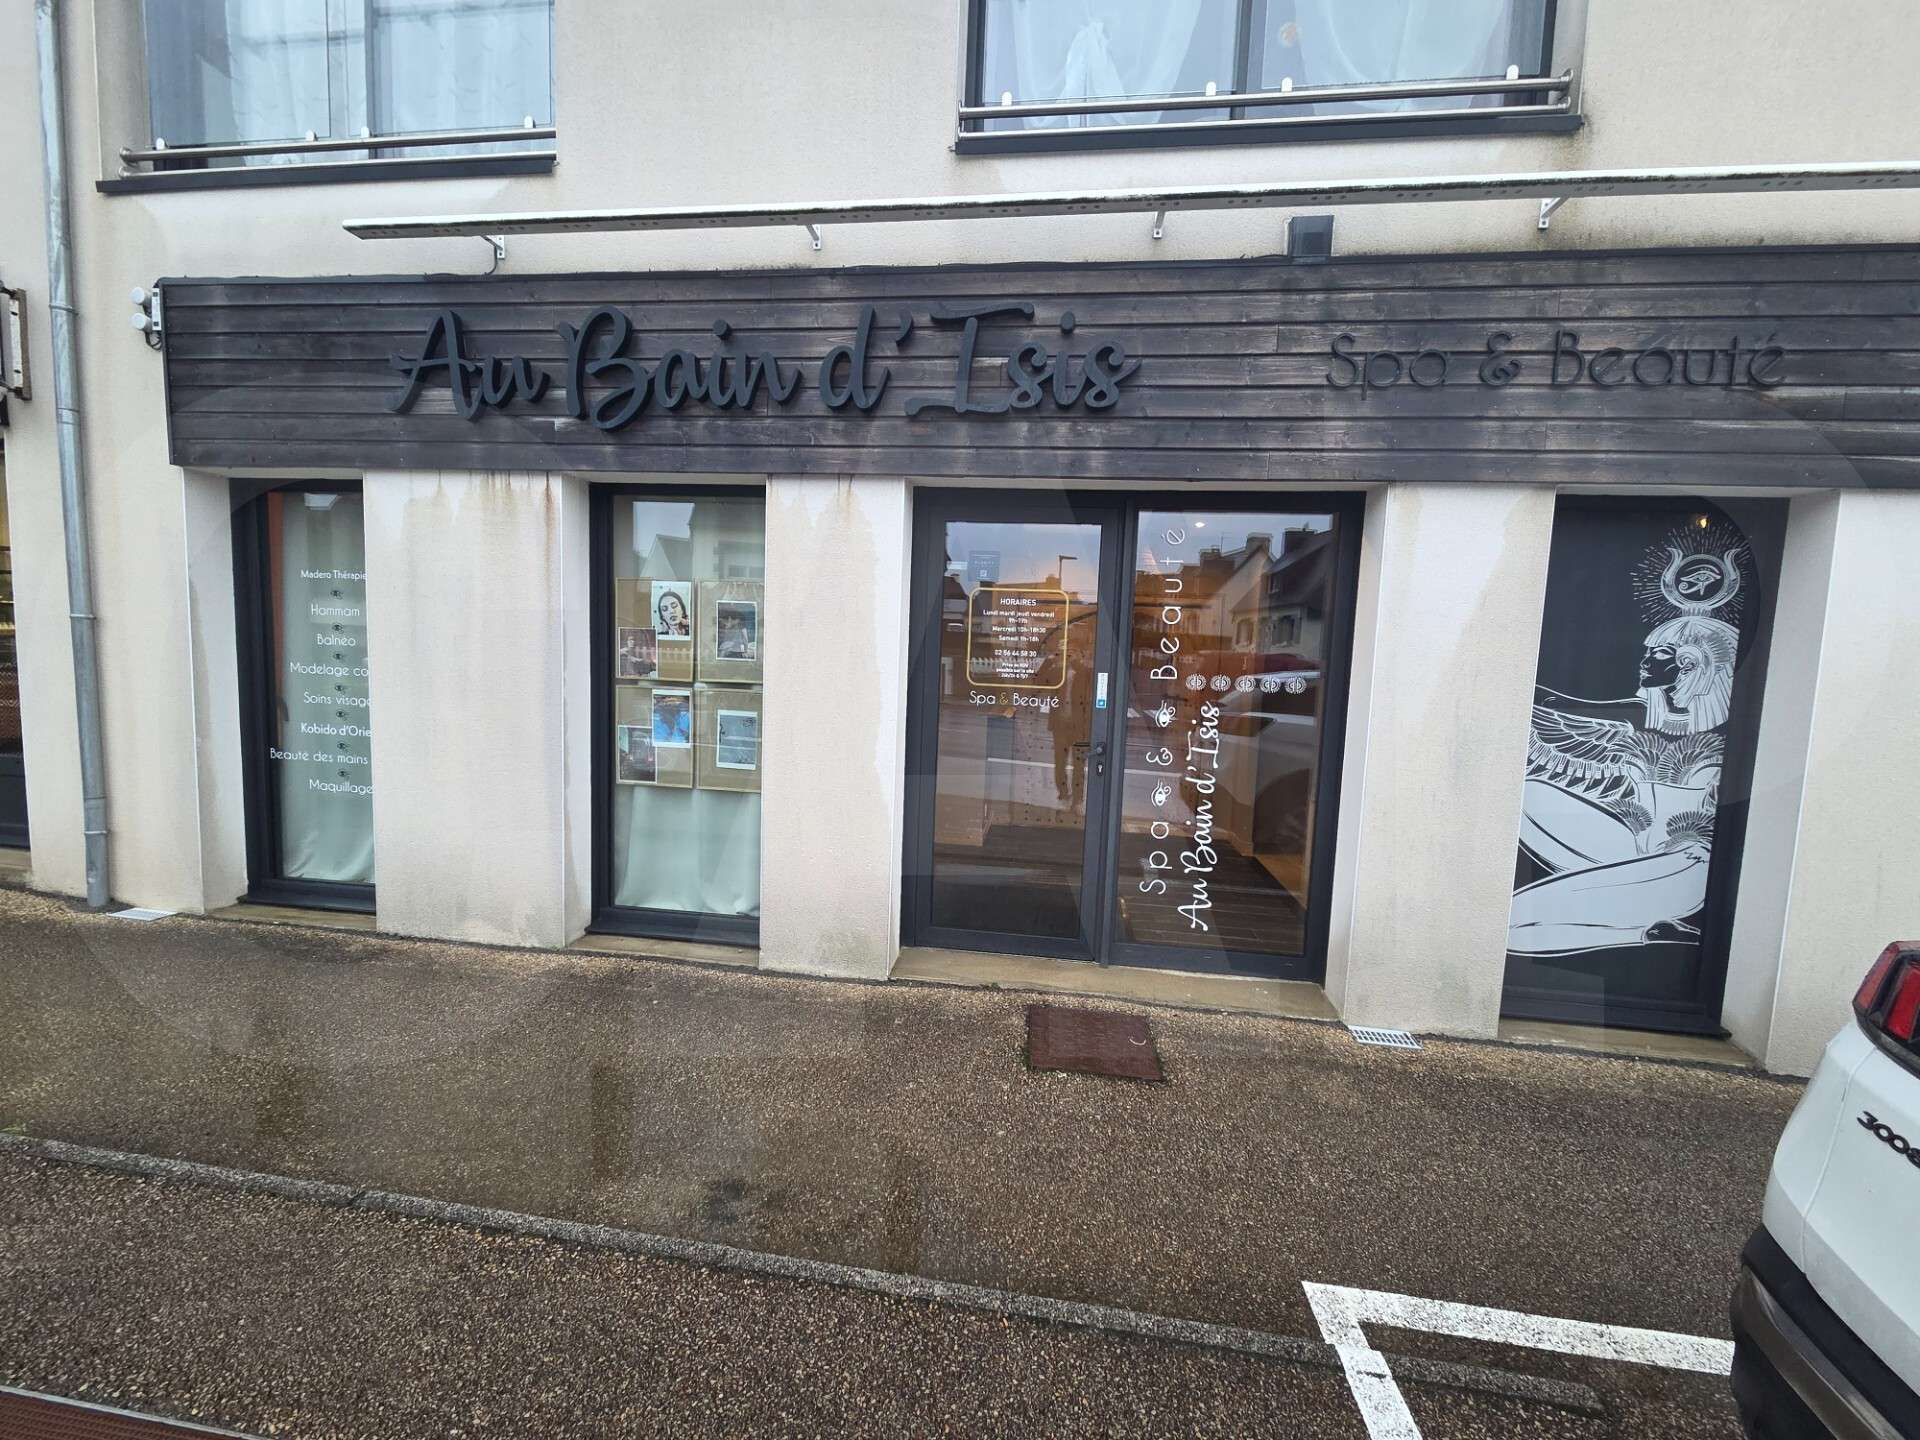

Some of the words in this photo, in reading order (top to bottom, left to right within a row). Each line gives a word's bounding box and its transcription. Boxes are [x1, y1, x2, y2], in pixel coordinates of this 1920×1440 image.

[385, 309, 550, 423] Au
[556, 305, 800, 432] Bain
[819, 301, 1142, 417] d'Isis
[1326, 332, 1451, 400] Spa
[1478, 331, 1522, 387] &
[1551, 328, 1788, 391] Beauté
[300, 569, 332, 579] Madero
[311, 603, 360, 617] Hammam
[1000, 598, 1037, 606] HORAIRES
[1150, 528, 1185, 680] Beauté
[290, 661, 350, 677] Modelage
[303, 691, 332, 704] Soins
[969, 690, 996, 707] Spa
[999, 692, 1009, 705] &
[1013, 692, 1060, 708] Beauté
[300, 722, 337, 735] Kobido
[1146, 747, 1173, 766] &
[1185, 701, 1220, 794] d'Isis
[313, 751, 333, 762] des
[337, 755, 368, 765] mains
[309, 779, 375, 795] Maquillage
[1180, 800, 1217, 874] Bain
[1139, 821, 1173, 895] Spa
[1177, 878, 1212, 931] Au
